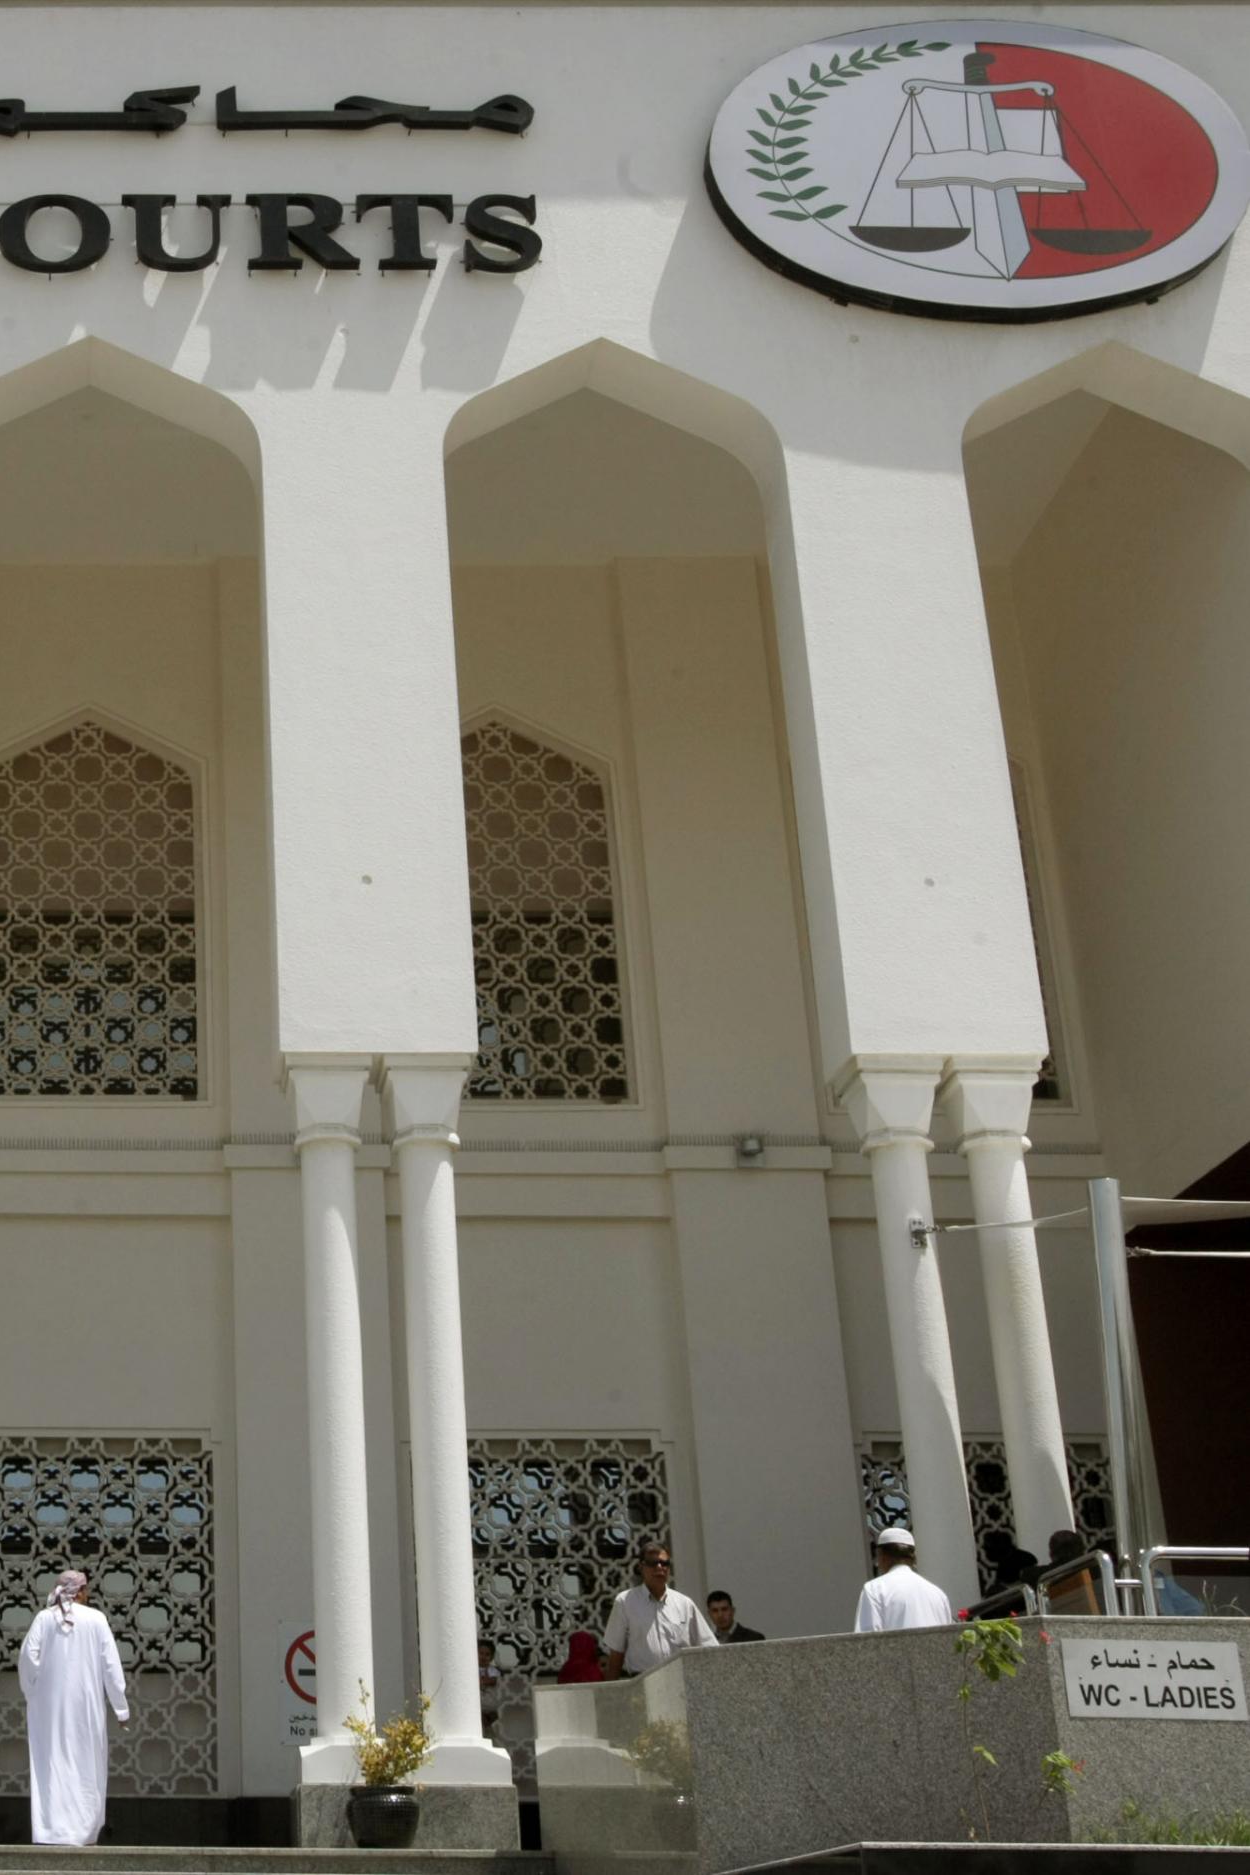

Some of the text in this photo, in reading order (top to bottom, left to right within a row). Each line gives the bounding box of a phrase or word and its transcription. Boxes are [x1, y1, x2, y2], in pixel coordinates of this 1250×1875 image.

[1090, 1649, 1141, 1670] نساء
[1167, 1651, 1216, 1679] حمام
[1079, 1684, 1121, 1706] WC
[1144, 1685, 1236, 1709] LADIES
[290, 1726, 306, 1736] No
